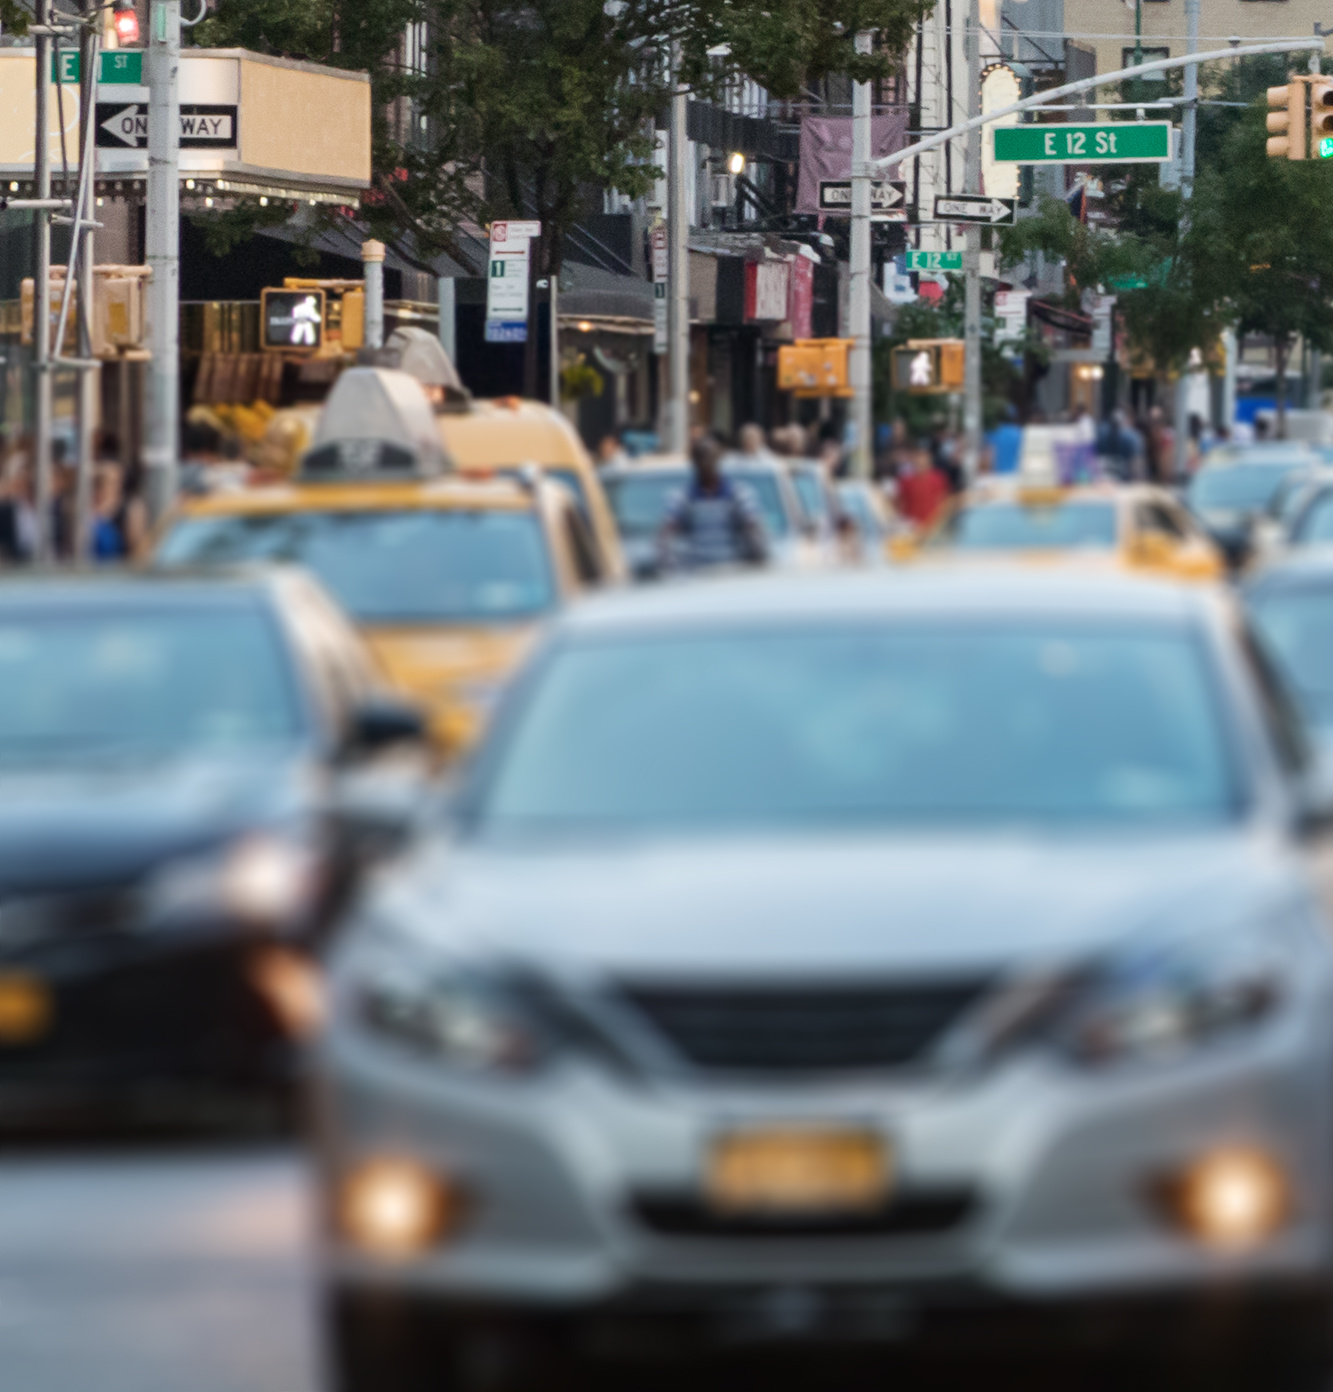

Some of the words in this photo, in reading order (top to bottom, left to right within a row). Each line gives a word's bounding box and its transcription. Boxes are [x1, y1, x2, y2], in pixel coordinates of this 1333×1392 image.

[61, 54, 76, 81] E
[114, 55, 128, 68] ST
[121, 117, 148, 134] ON
[180, 118, 222, 135] WAY
[1045, 132, 1057, 155] E
[1066, 131, 1086, 155] 12
[1095, 130, 1117, 154] St
[832, 189, 850, 201] ON
[912, 252, 920, 268] E
[926, 252, 942, 268] 12
